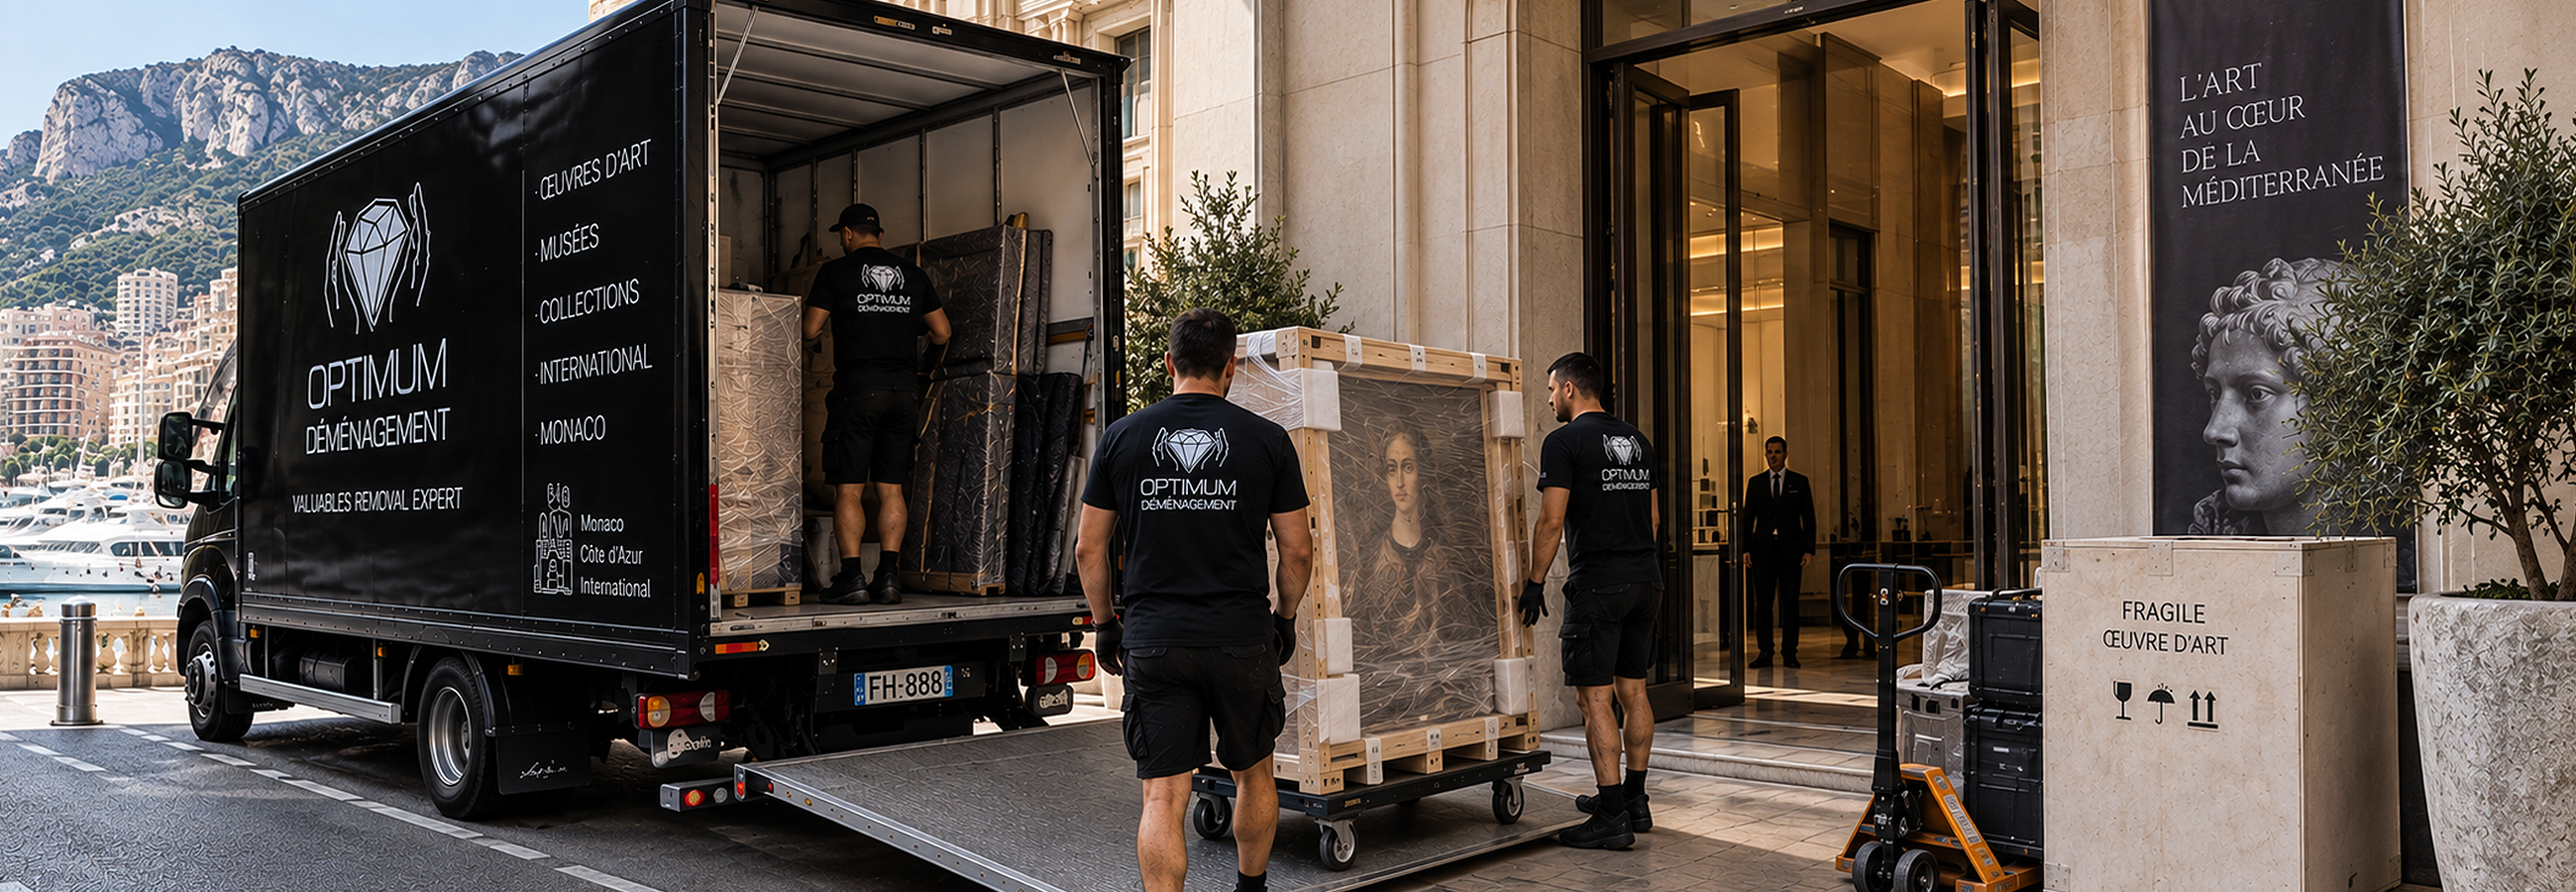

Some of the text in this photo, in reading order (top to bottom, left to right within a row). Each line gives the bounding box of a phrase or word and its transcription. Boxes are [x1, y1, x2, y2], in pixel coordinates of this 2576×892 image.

[2180, 61, 2262, 102] L'ART
[2180, 94, 2306, 140] AU CŒUR
[2226, 139, 2262, 167] LA
[540, 138, 652, 201] ŒUVRES D'ART
[2181, 152, 2385, 208] MÉDITERRANÉE
[540, 222, 599, 263] MUSÉES
[540, 278, 640, 324] COLLECTIONS
[307, 337, 447, 409] OPTIMUM
[540, 343, 653, 385] INTERNATIONAL
[305, 407, 451, 455] DÉMÉNAGEMENT
[540, 414, 606, 445] MONACO
[292, 487, 464, 513] VALUABLES REMOVAL EXPERT
[1140, 478, 1237, 497] OPTIMUM
[1140, 495, 1237, 511] DÉMÉNAGEMENT
[581, 513, 624, 532] Monaco
[580, 544, 644, 565] Côte d'Azur
[580, 576, 651, 599] International
[2122, 601, 2205, 624] FRAGILE
[2102, 629, 2229, 655] ŒUVRE D'ART
[868, 670, 942, 701] FH-888
